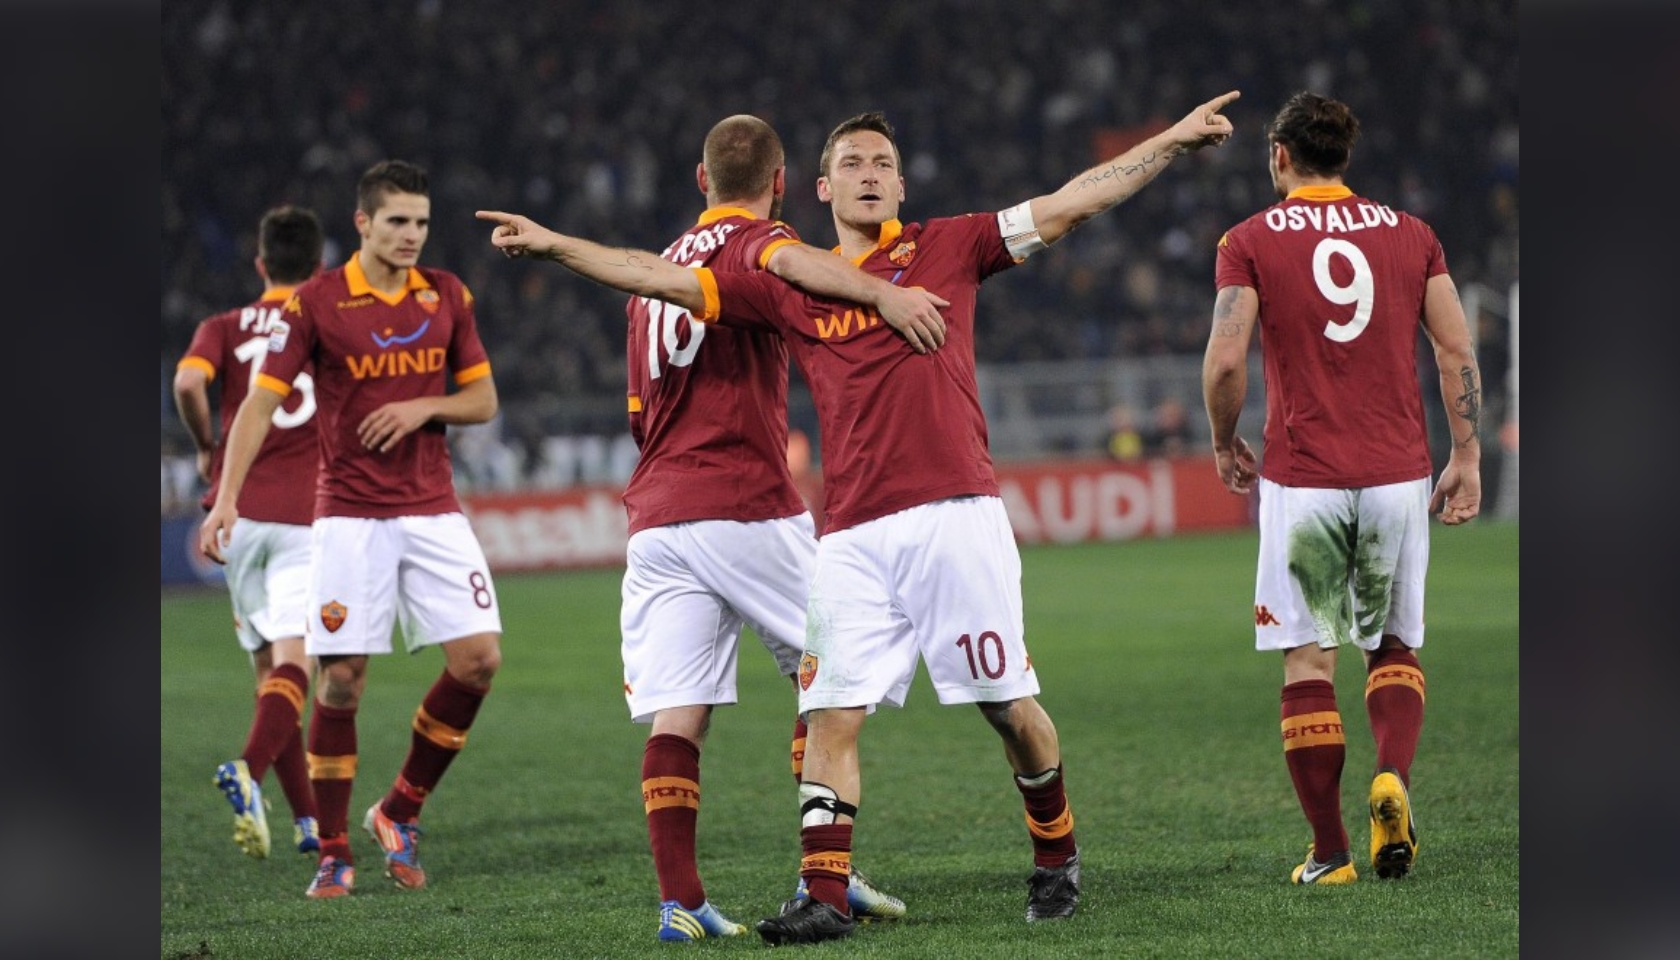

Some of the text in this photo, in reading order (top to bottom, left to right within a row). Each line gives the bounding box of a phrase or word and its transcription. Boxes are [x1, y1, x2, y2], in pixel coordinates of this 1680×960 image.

[1265, 203, 1399, 233] OSVALDO
[1312, 237, 1375, 342] 9
[814, 307, 878, 338] WI
[346, 347, 446, 379] WIND
[998, 458, 1175, 545] AUDI
[468, 571, 491, 610] 8
[955, 630, 1006, 681] 10
